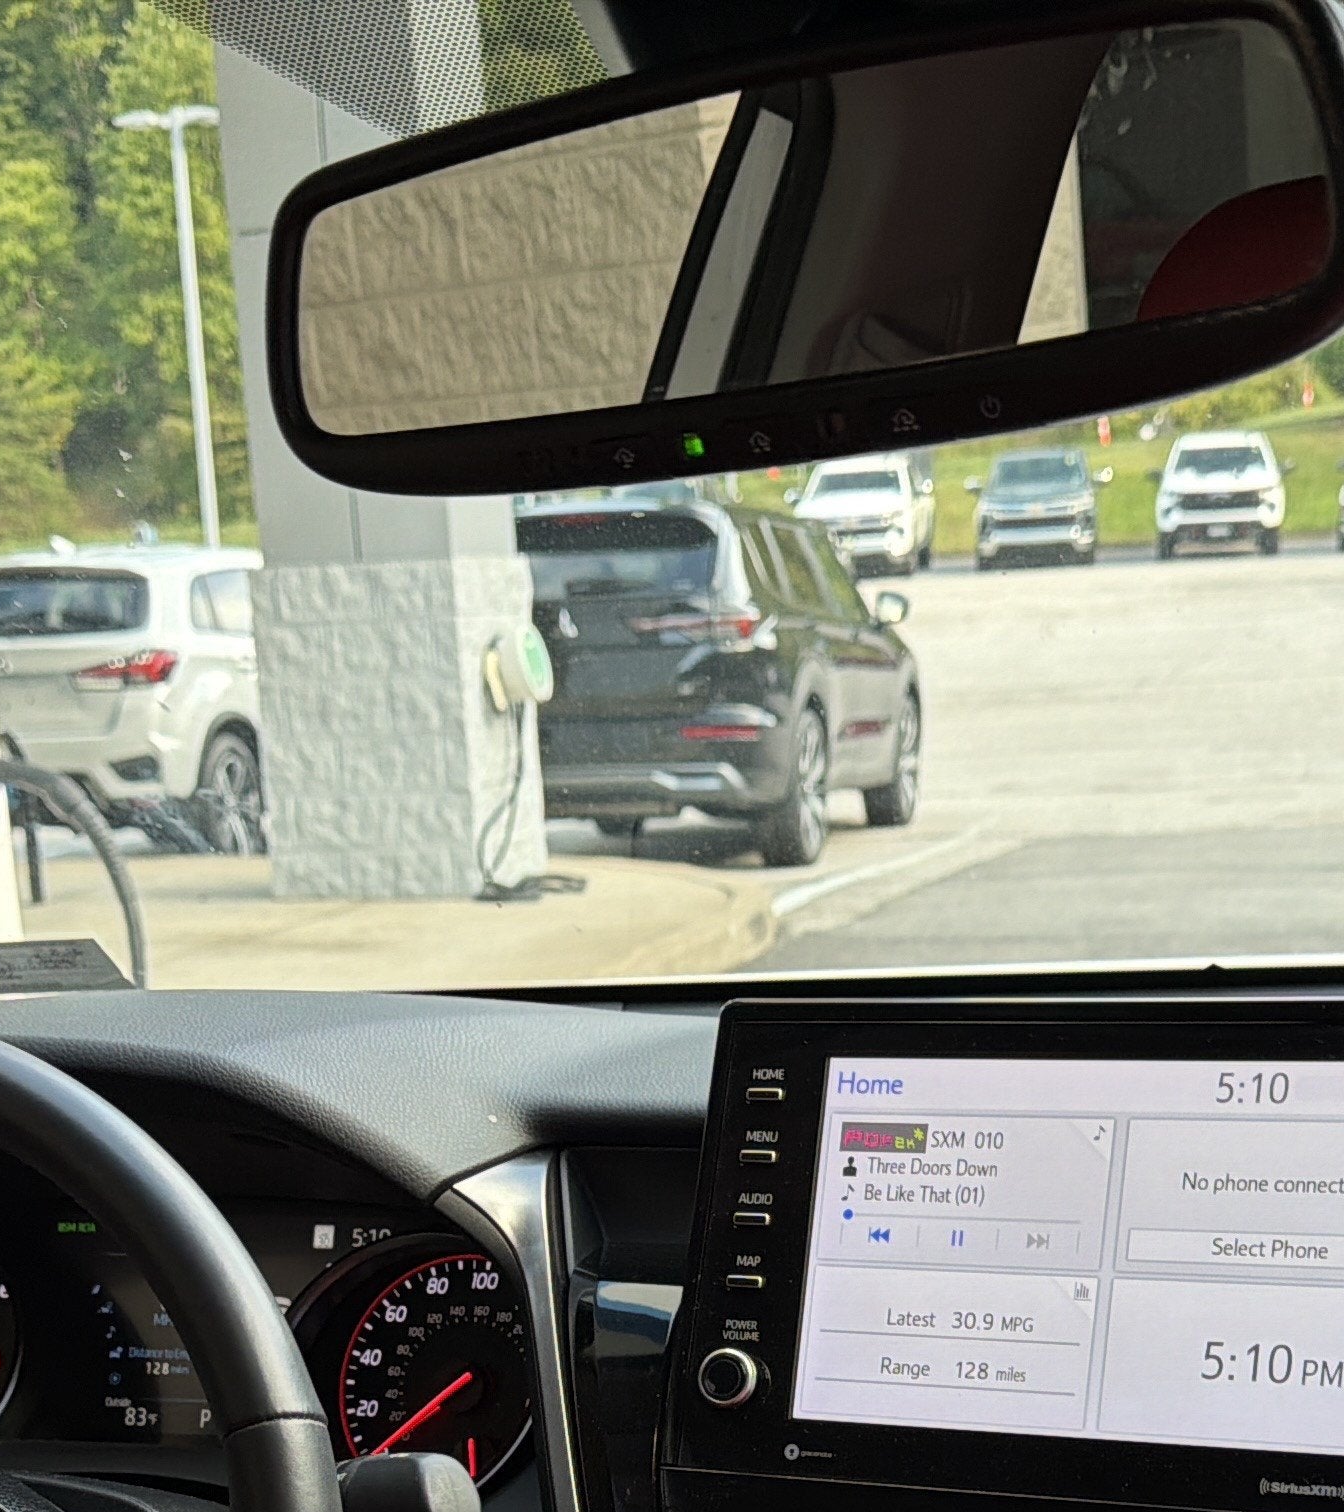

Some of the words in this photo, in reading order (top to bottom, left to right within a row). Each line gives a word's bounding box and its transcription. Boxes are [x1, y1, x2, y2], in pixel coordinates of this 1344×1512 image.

[753, 1069, 785, 1080] HOME
[837, 1071, 904, 1095] Home
[1215, 1071, 1290, 1104] 5:10
[745, 1130, 778, 1143] MENU
[931, 1130, 965, 1149] SXM
[974, 1130, 1005, 1150] 010
[868, 1156, 908, 1175] Three
[910, 1157, 952, 1177] Doors
[956, 1159, 998, 1178] Down
[1182, 1172, 1209, 1192] No
[1213, 1174, 1269, 1195] phone
[738, 1192, 773, 1206] AUDIO
[864, 1184, 883, 1202] Be
[887, 1184, 915, 1202] Like
[920, 1185, 952, 1204] That
[954, 1186, 986, 1208] (01)
[1211, 1237, 1266, 1258] Select
[1271, 1239, 1329, 1260] Phone
[736, 1254, 761, 1267] MAP
[426, 1277, 449, 1295] 80
[471, 1272, 499, 1290] 100
[384, 1305, 407, 1323] 60
[427, 1312, 443, 1324] 120
[449, 1306, 466, 1317] 140
[473, 1306, 490, 1317] 160
[496, 1312, 513, 1322] 180
[725, 1319, 758, 1331] POWER
[886, 1308, 937, 1329] Latest
[951, 1311, 994, 1331] 30.9
[1000, 1316, 1034, 1333] MPG
[408, 1327, 425, 1338] 100
[722, 1330, 760, 1342] VOLUME
[359, 1349, 382, 1367] 40
[396, 1345, 410, 1356] 80
[145, 1361, 170, 1376] 128
[387, 1366, 401, 1376] 60
[880, 1356, 931, 1379] Range
[956, 1360, 989, 1381] 128
[995, 1366, 1027, 1383] miles
[1201, 1341, 1294, 1384] 5:10
[1301, 1360, 1344, 1388] PM
[385, 1388, 399, 1399] 40
[356, 1399, 379, 1418] 20
[388, 1411, 402, 1422] 20
[199, 1408, 212, 1428] P
